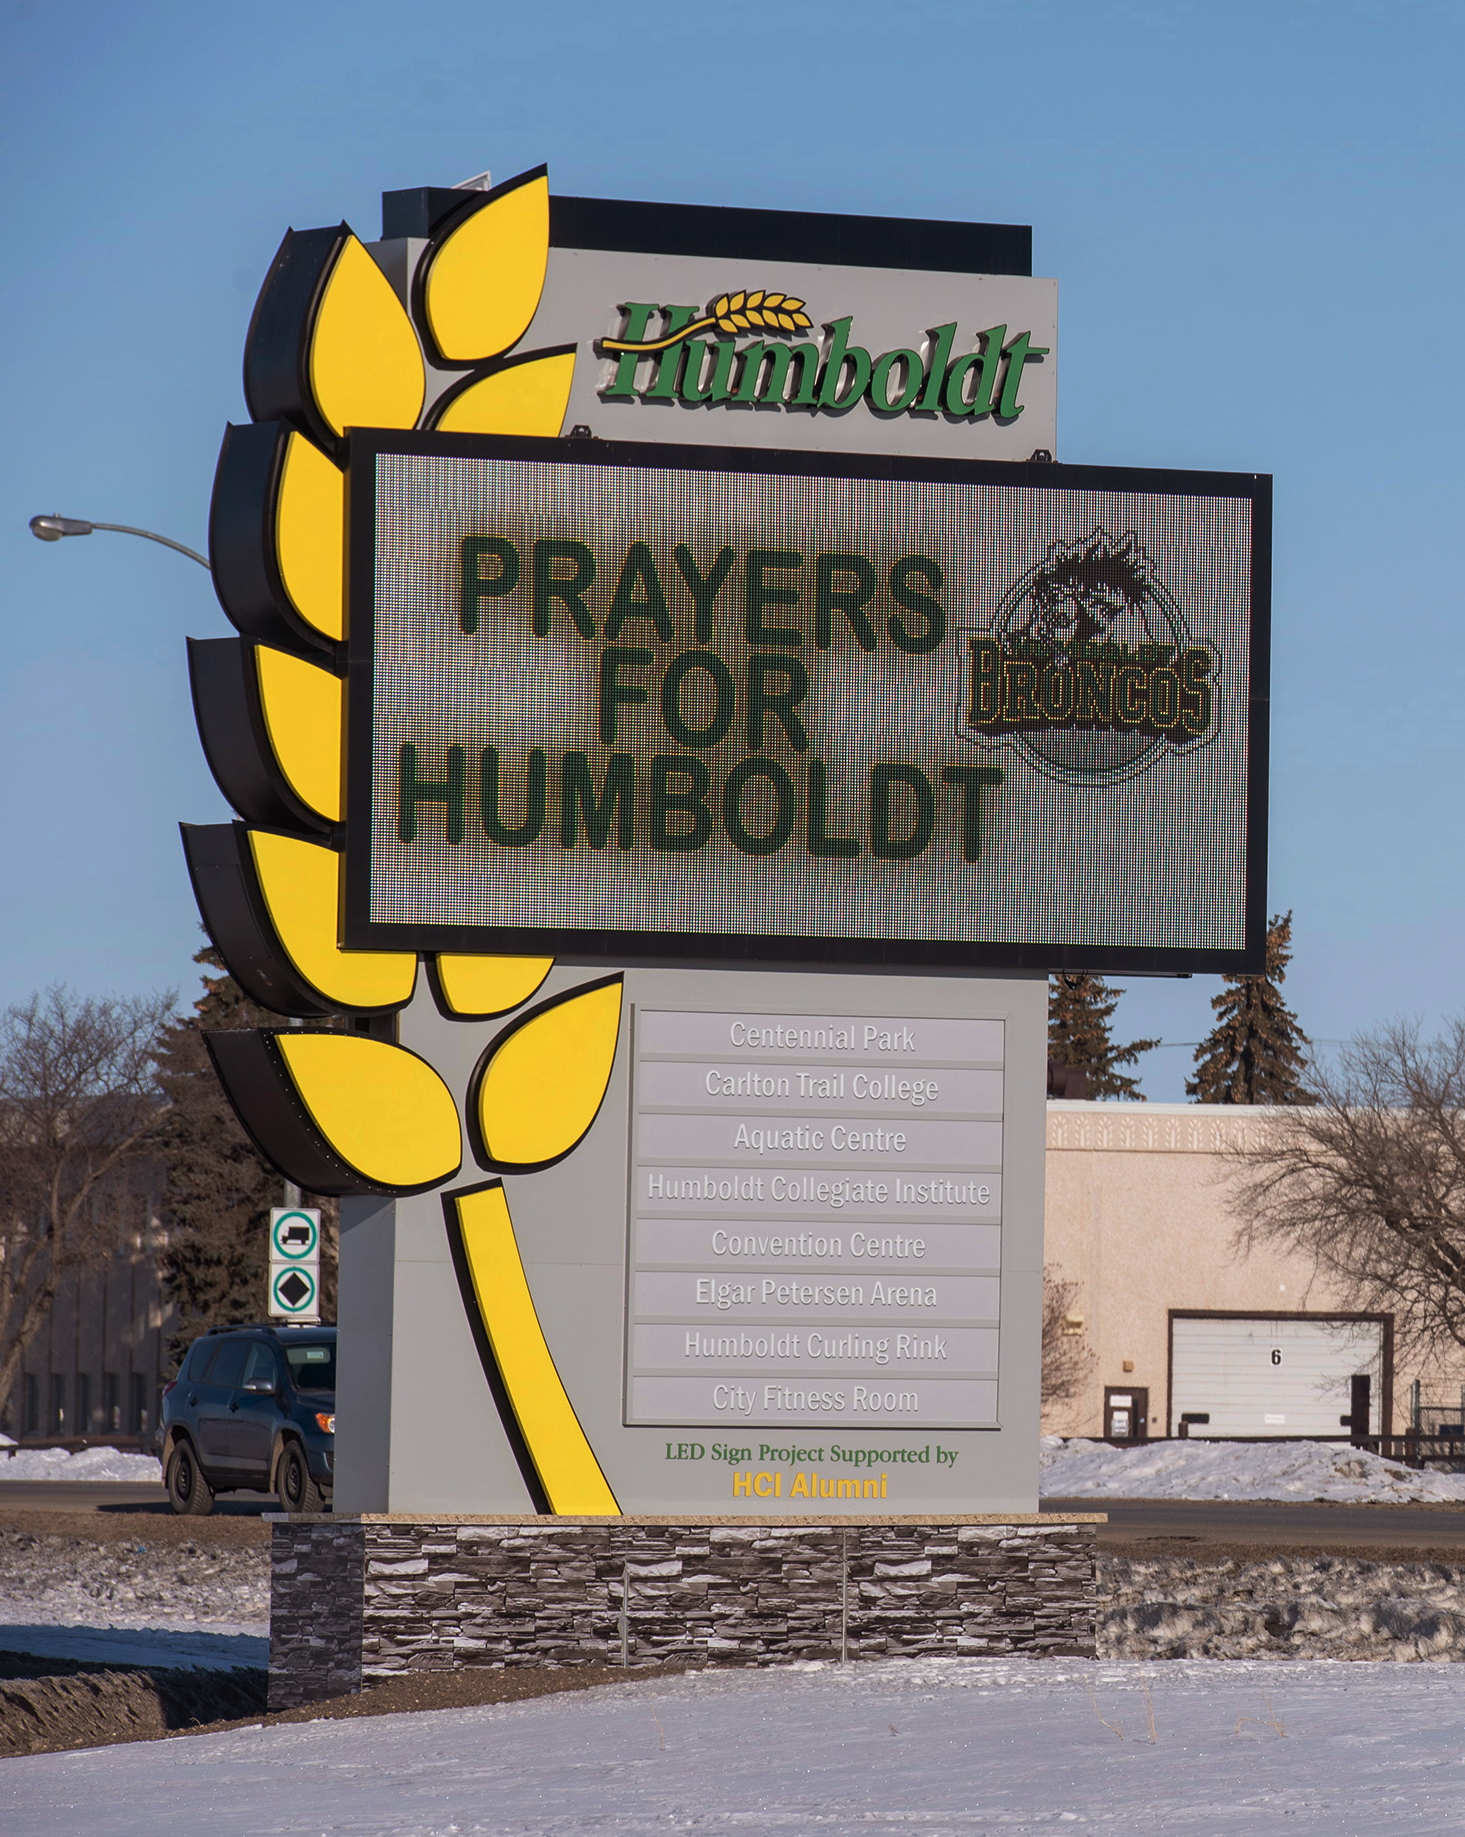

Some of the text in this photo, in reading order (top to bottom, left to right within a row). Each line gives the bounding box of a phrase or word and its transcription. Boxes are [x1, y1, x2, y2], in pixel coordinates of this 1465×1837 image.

[602, 301, 1050, 418] Humboldt
[460, 535, 948, 655] PRAYERS
[599, 647, 810, 753] FOR
[967, 637, 1213, 735] BRONCOS
[398, 740, 1005, 864] HUMBOLDT
[730, 1021, 916, 1052] Centennial Park
[705, 1070, 939, 1106] Carlton Trail College
[734, 1123, 907, 1155] Aquatic Centre
[648, 1174, 990, 1208] Humboldt Collegiate Institute
[711, 1230, 926, 1258] Convention Centre
[695, 1279, 938, 1310] Elgar Petersen Arena
[684, 1331, 948, 1365] Humboldt Curling Rink
[1271, 1349, 1282, 1366] 6
[713, 1384, 919, 1416] City Fitness Room
[665, 1442, 959, 1468] LED Sign Project Supported by
[732, 1472, 888, 1498] HCI Alumni
